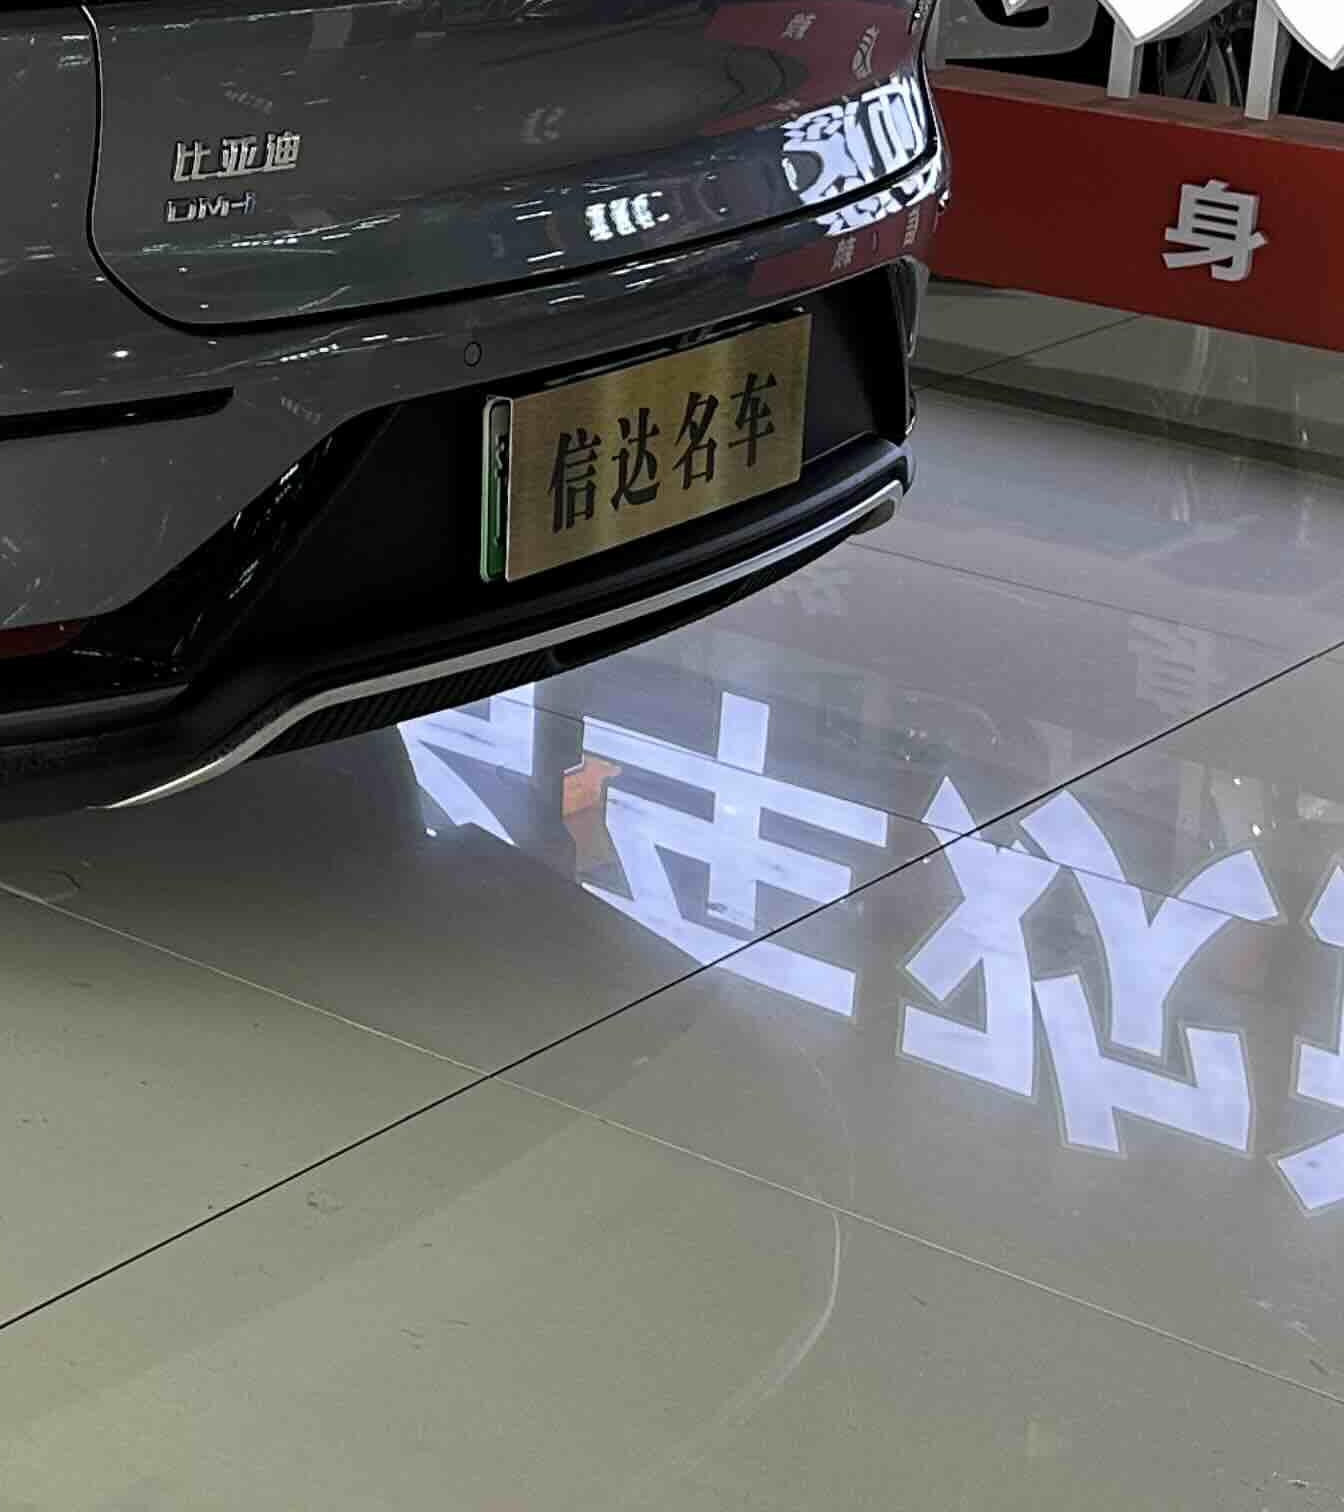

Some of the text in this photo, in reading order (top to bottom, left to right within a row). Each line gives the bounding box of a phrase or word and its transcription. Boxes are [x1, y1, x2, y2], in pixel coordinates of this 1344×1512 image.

[173, 130, 301, 182] 比亚迪
[1161, 178, 1268, 283] 身
[548, 372, 777, 535] 信达名车
